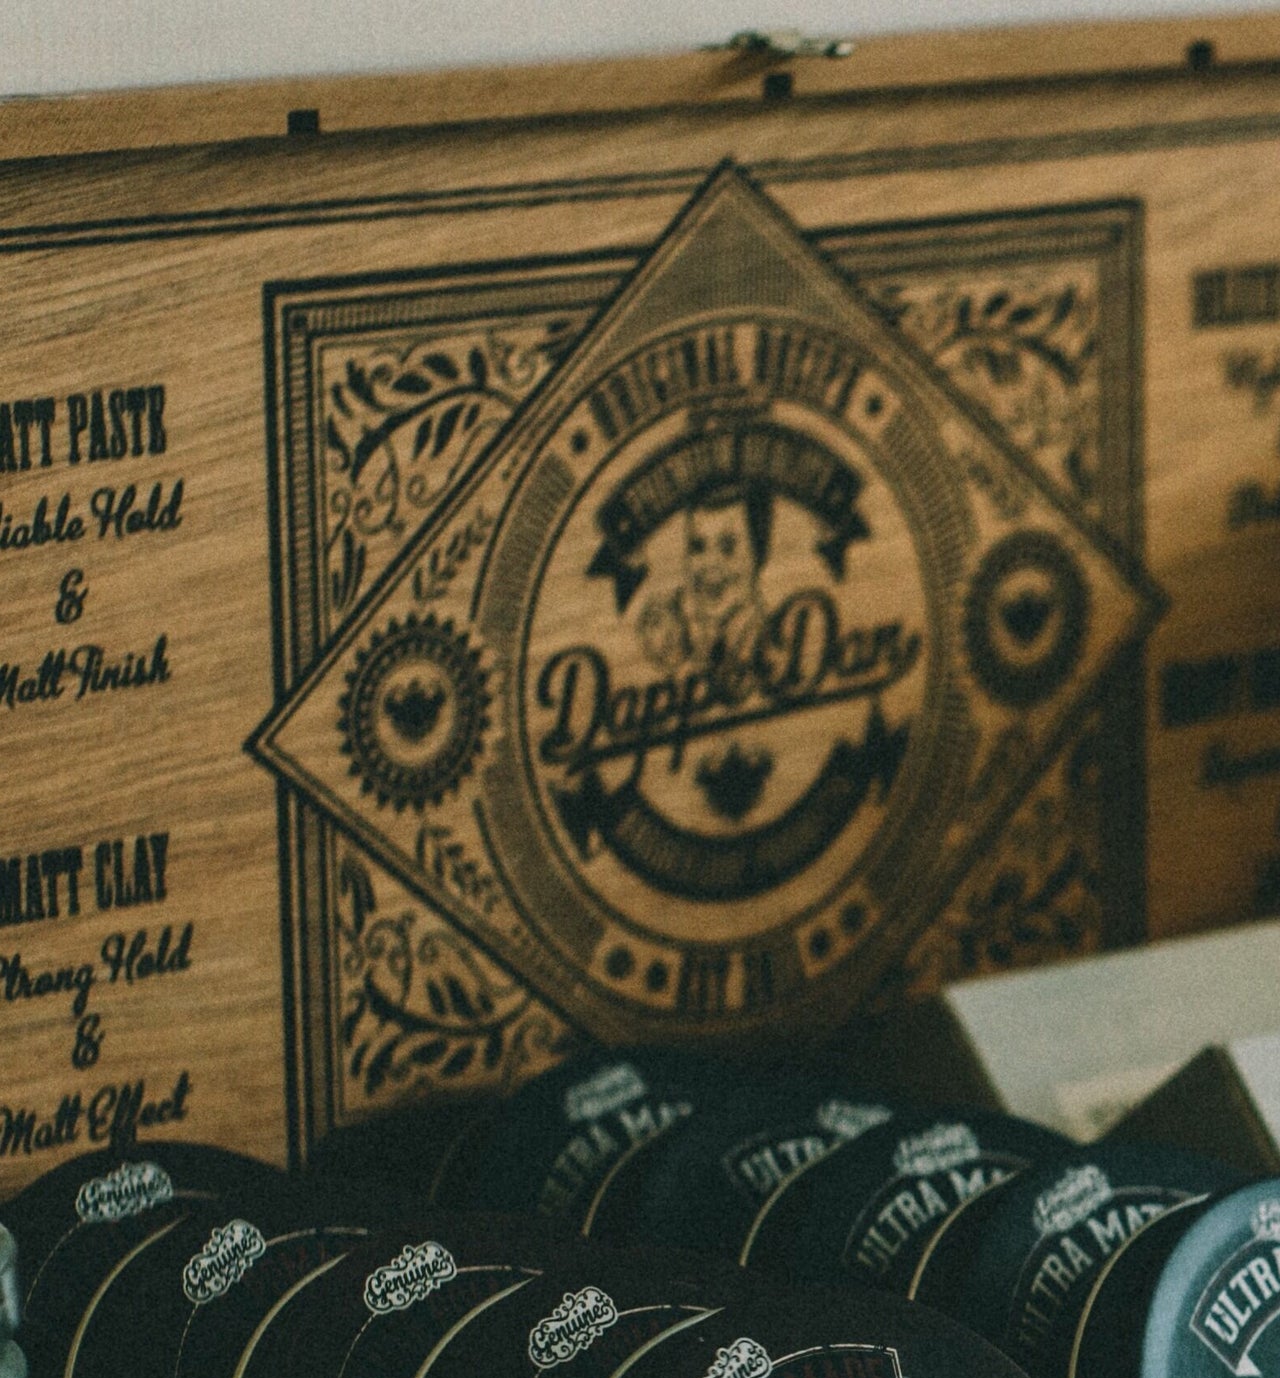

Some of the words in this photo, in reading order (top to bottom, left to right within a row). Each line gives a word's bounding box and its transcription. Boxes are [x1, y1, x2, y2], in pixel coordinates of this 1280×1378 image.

[0, 396, 55, 473] ATT
[67, 384, 167, 466] PASTE
[0, 492, 85, 549] iable
[91, 476, 184, 540] Hold
[55, 567, 88, 624] &
[68, 632, 171, 701] Finish
[0, 845, 82, 926] MATT
[95, 832, 169, 911] CLAY
[101, 921, 193, 985] Hold
[72, 1013, 105, 1070] &
[0, 1091, 81, 1155] Matt
[87, 1069, 194, 1148] Effect
[187, 1232, 260, 1298] Genuine
[367, 1256, 447, 1310] Genuine
[530, 1303, 608, 1363] Genuine
